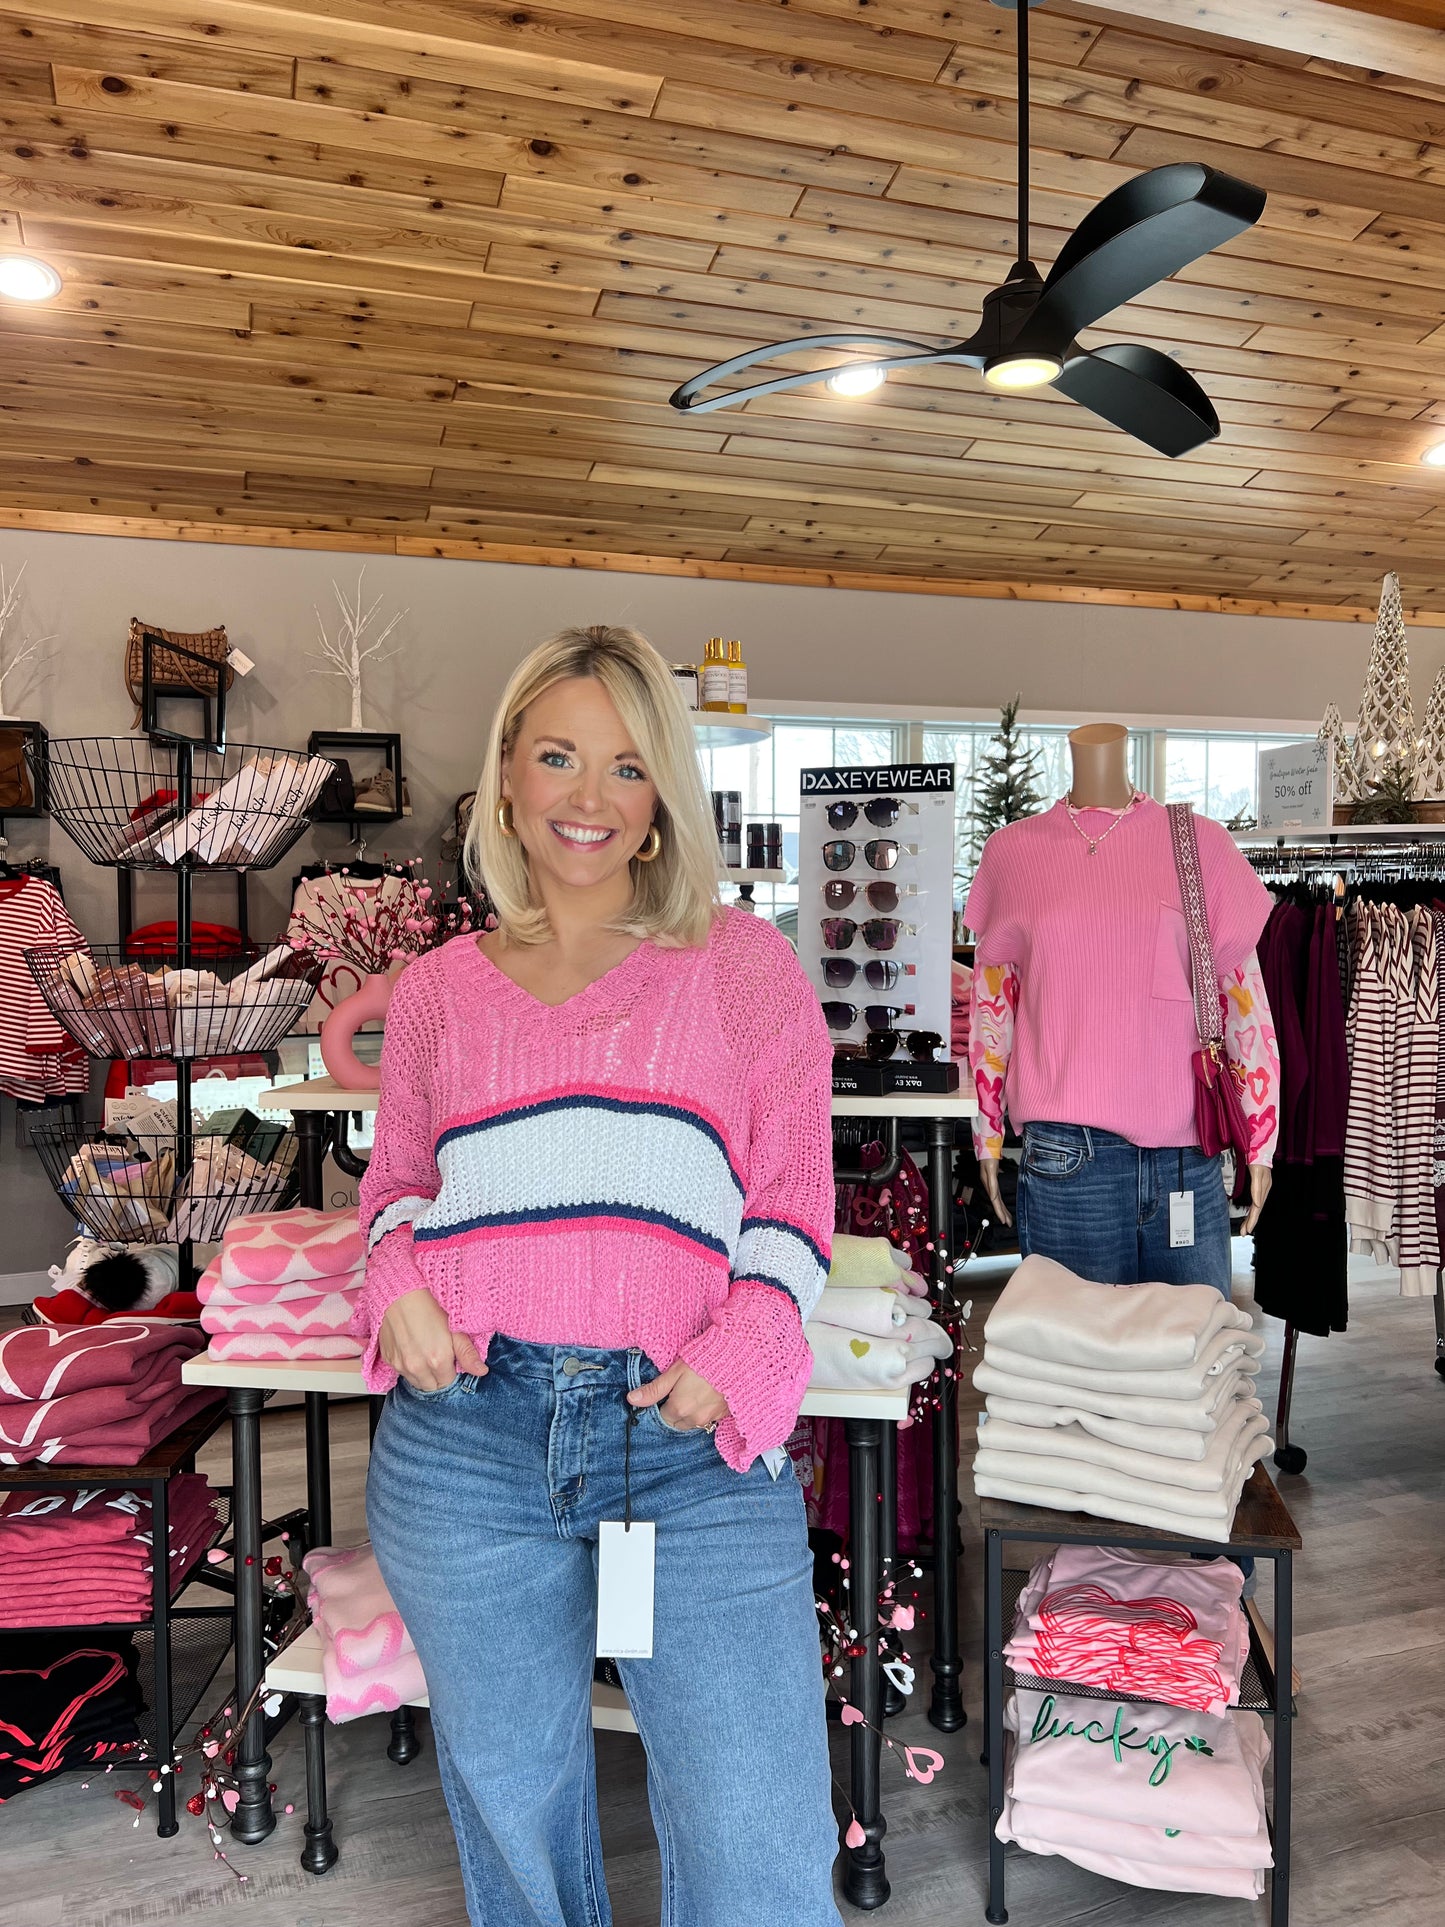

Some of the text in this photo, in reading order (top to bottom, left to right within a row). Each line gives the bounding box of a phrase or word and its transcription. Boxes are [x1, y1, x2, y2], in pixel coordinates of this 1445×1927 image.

[1274, 780, 1313, 799] 50% off
[0, 1488, 153, 1518] OVE
[1030, 1694, 1181, 1787] lucky
